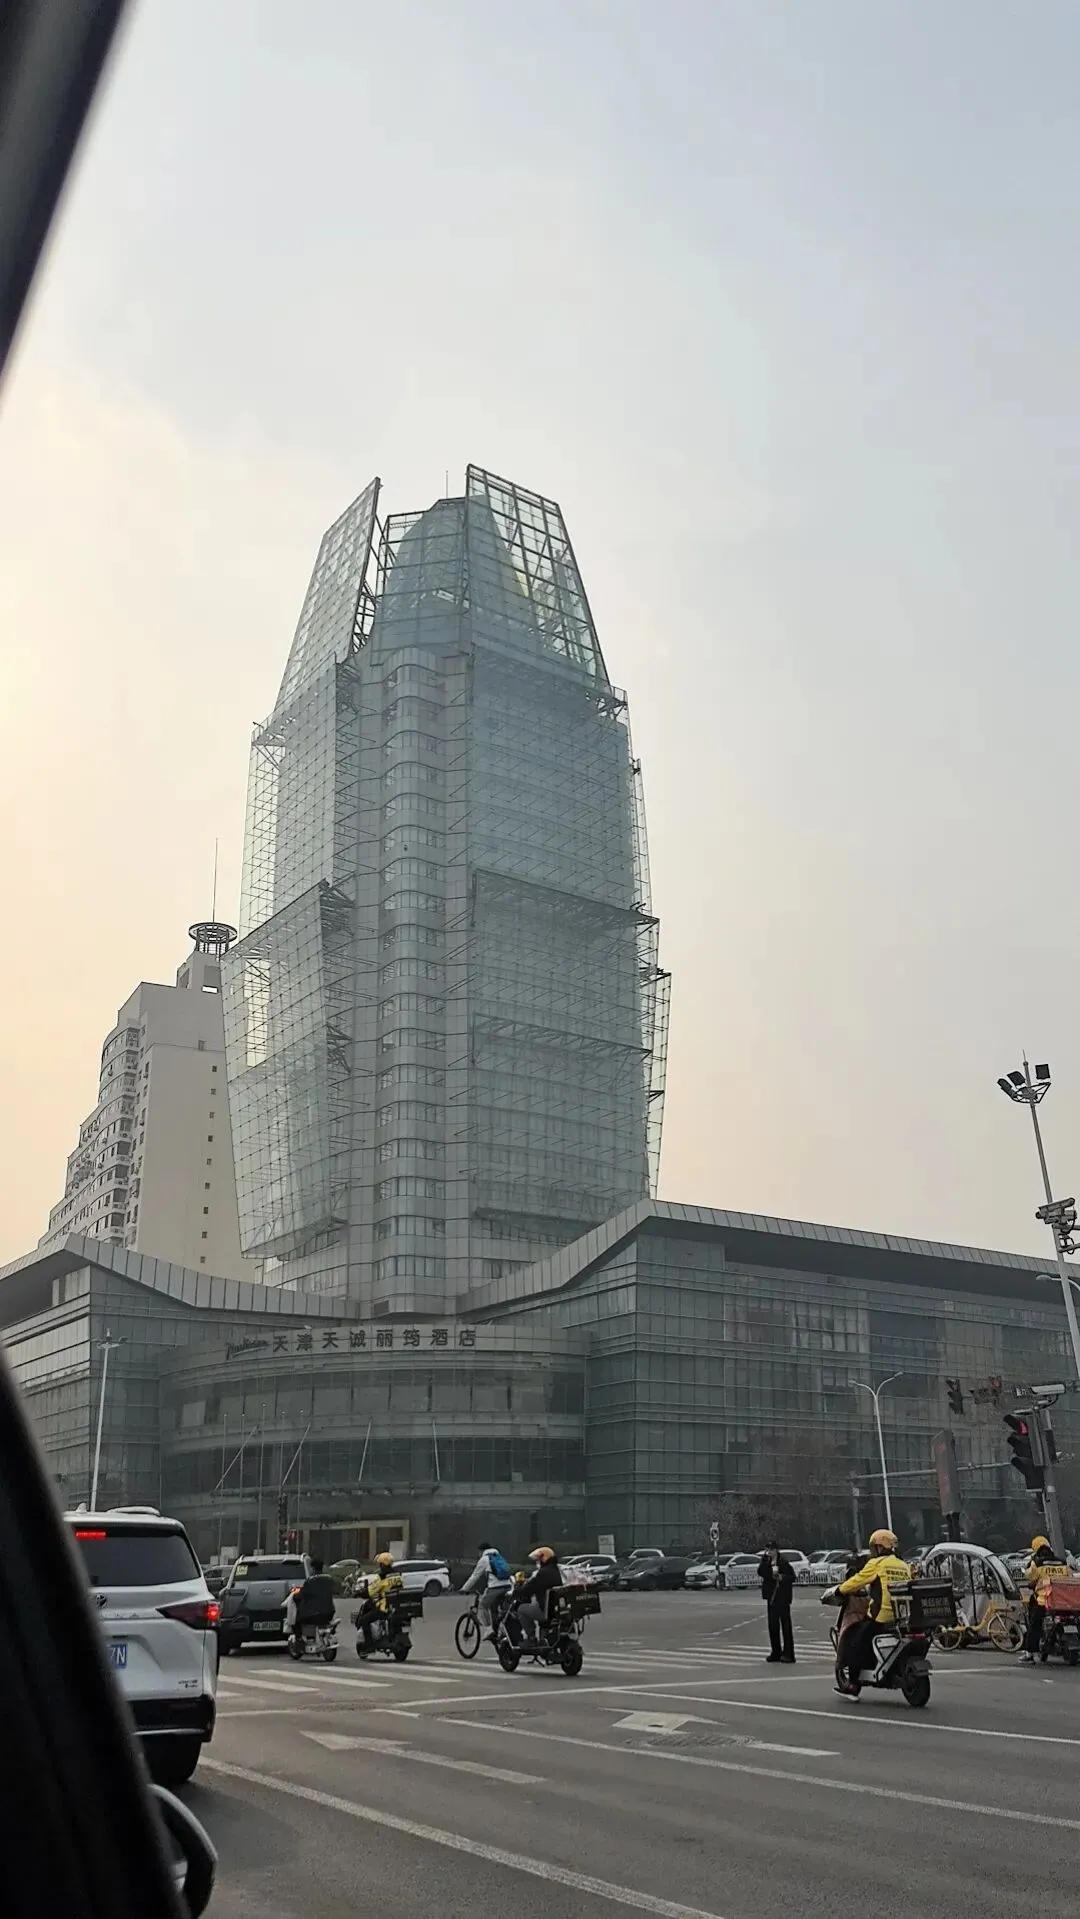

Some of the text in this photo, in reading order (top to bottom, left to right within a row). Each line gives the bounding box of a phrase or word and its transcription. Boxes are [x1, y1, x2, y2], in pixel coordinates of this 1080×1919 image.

[272, 1328, 477, 1353] 天津天诚丽筠酒店
